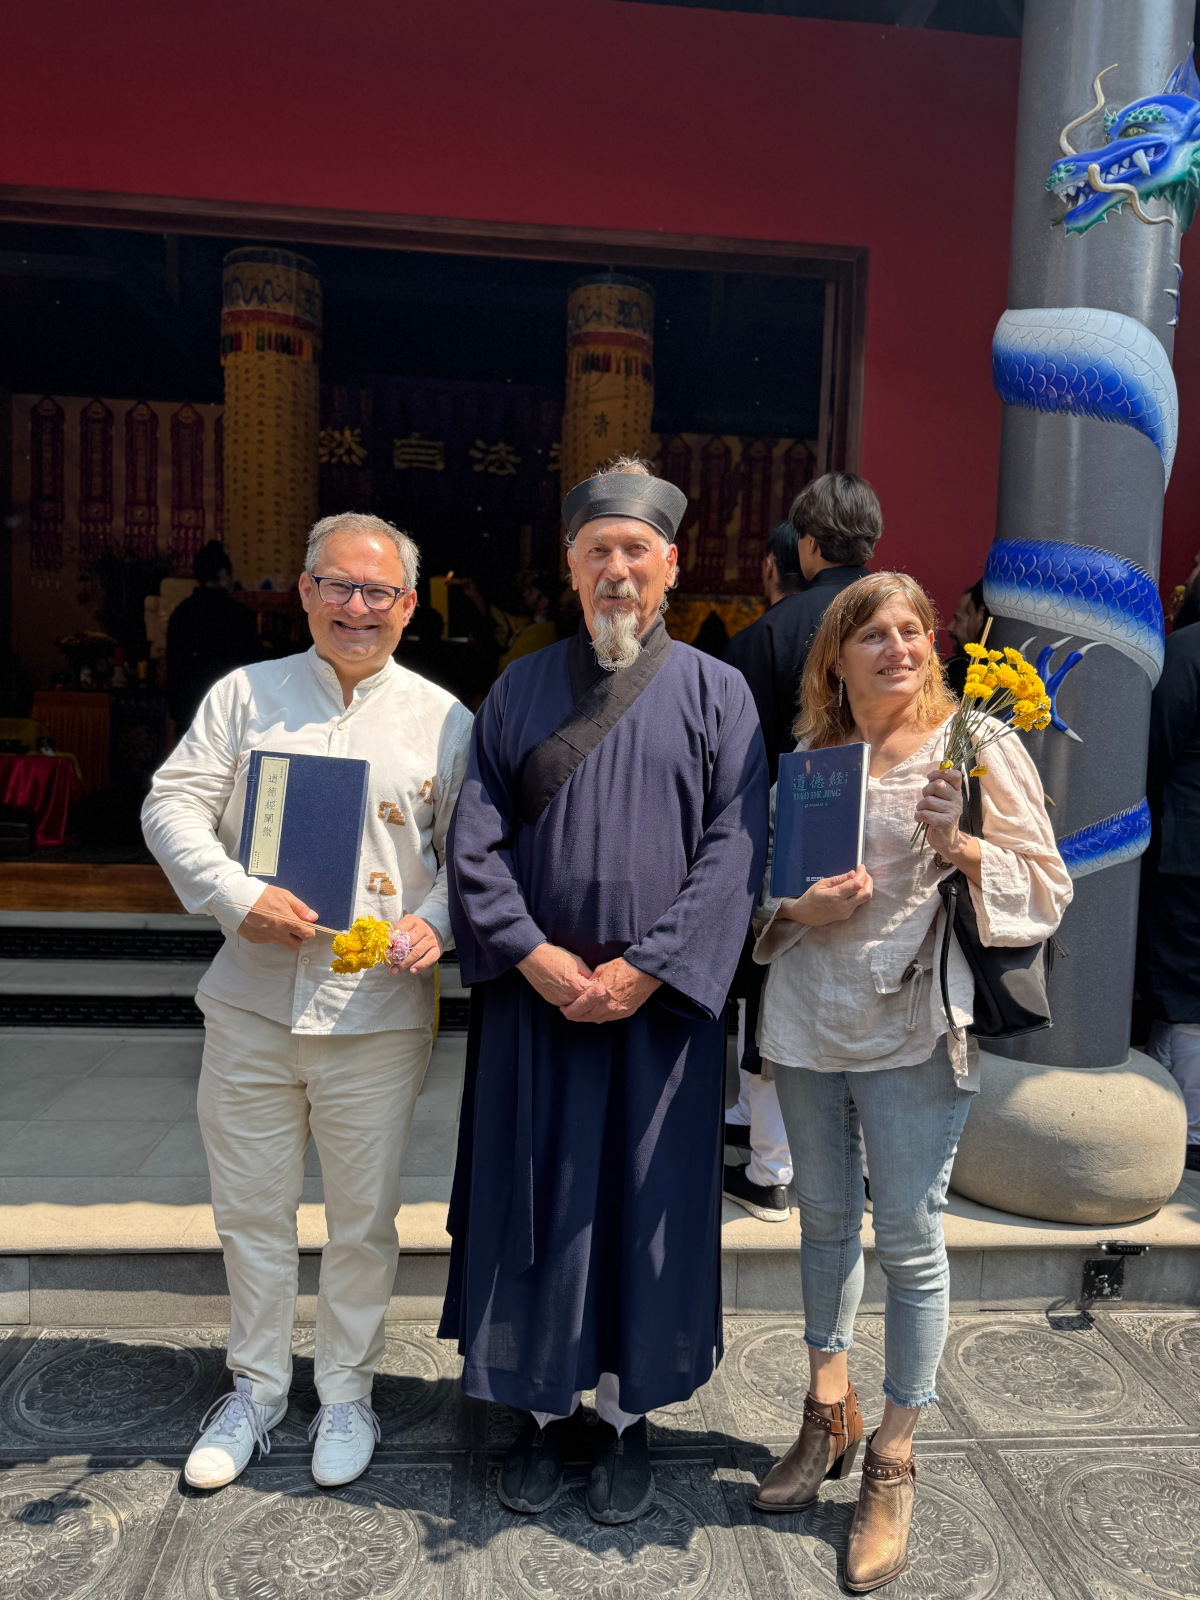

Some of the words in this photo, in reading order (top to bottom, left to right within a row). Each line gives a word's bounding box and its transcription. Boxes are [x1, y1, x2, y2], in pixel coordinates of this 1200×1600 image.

[793, 792, 810, 800] DAO
[810, 790, 822, 799] DE
[822, 789, 841, 798] JING
